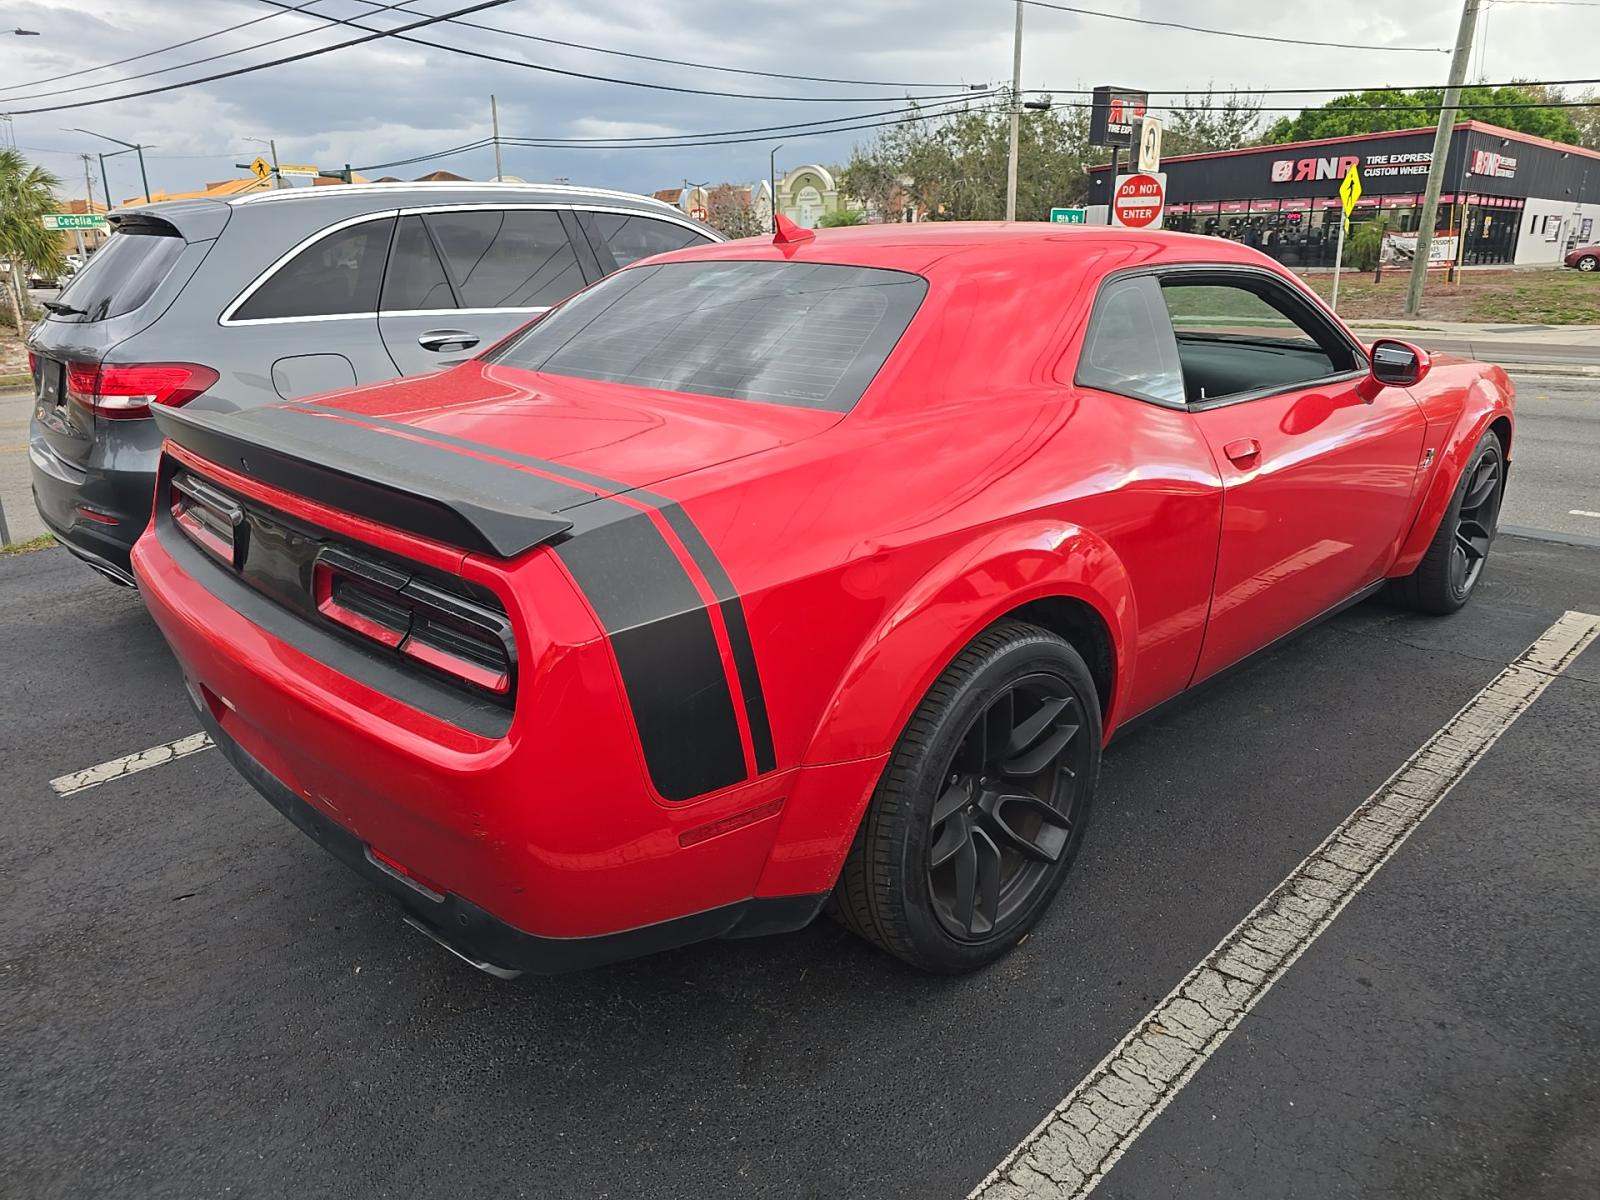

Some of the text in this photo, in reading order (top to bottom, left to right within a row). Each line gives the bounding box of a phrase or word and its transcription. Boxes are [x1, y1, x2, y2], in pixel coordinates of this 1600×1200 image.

[1366, 156, 1389, 164] TIRE
[1364, 168, 1399, 177] CUSTOM
[1122, 184, 1158, 195] DO NOT
[1122, 209, 1153, 219] ENTER
[58, 216, 92, 225] Cecelia
